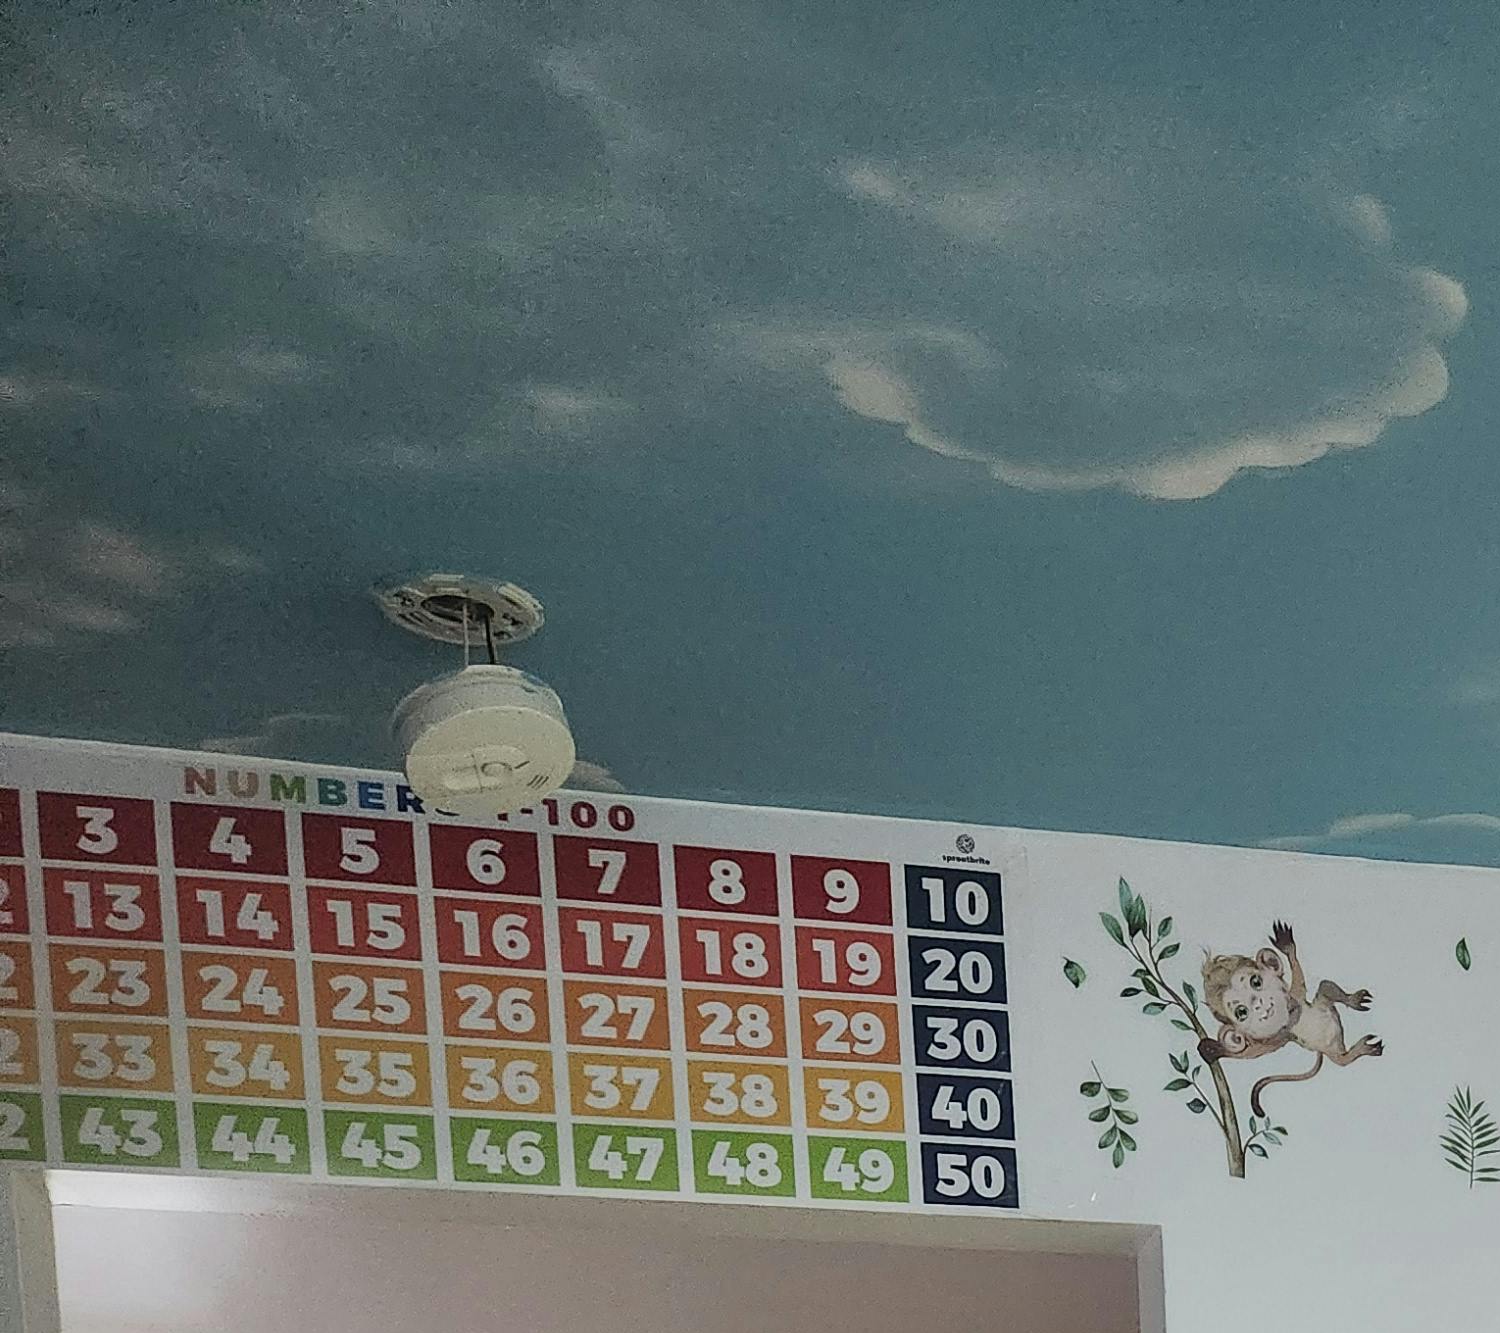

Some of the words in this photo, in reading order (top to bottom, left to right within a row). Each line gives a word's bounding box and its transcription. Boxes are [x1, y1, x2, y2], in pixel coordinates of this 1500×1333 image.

[184, 767, 461, 816] NUMBER
[77, 806, 118, 854] 3
[210, 817, 251, 863] 4
[340, 828, 379, 873] 5
[467, 839, 505, 884] 6
[588, 849, 626, 894] 7
[709, 860, 745, 904] 8
[824, 870, 859, 913] 9
[922, 878, 988, 925] 10
[64, 881, 145, 931] 13
[197, 890, 279, 940] 14
[327, 900, 405, 949] 15
[454, 910, 530, 960] 16
[577, 920, 650, 968] 17
[696, 930, 768, 977] 18
[813, 939, 881, 986] 19
[922, 949, 992, 993] 20
[66, 957, 150, 1006] 23
[199, 965, 284, 1015] 24
[329, 975, 410, 1024] 25
[456, 985, 535, 1032] 26
[579, 993, 654, 1040] 27
[698, 1002, 772, 1048] 28
[814, 1010, 885, 1055] 29
[927, 1017, 997, 1062] 30
[73, 1033, 156, 1081] 33
[205, 1041, 289, 1090] 34
[336, 1049, 416, 1097] 35
[461, 1057, 540, 1104] 36
[584, 1065, 659, 1110] 37
[703, 1072, 777, 1117] 38
[819, 1079, 889, 1123] 39
[932, 1086, 1000, 1130] 40
[79, 1108, 162, 1157] 43
[212, 1116, 296, 1164] 44
[342, 1123, 421, 1169] 45
[467, 1129, 545, 1175] 46
[589, 1136, 663, 1181] 47
[708, 1142, 781, 1187] 48
[824, 1148, 894, 1192] 49
[936, 1153, 1004, 1197] 50
